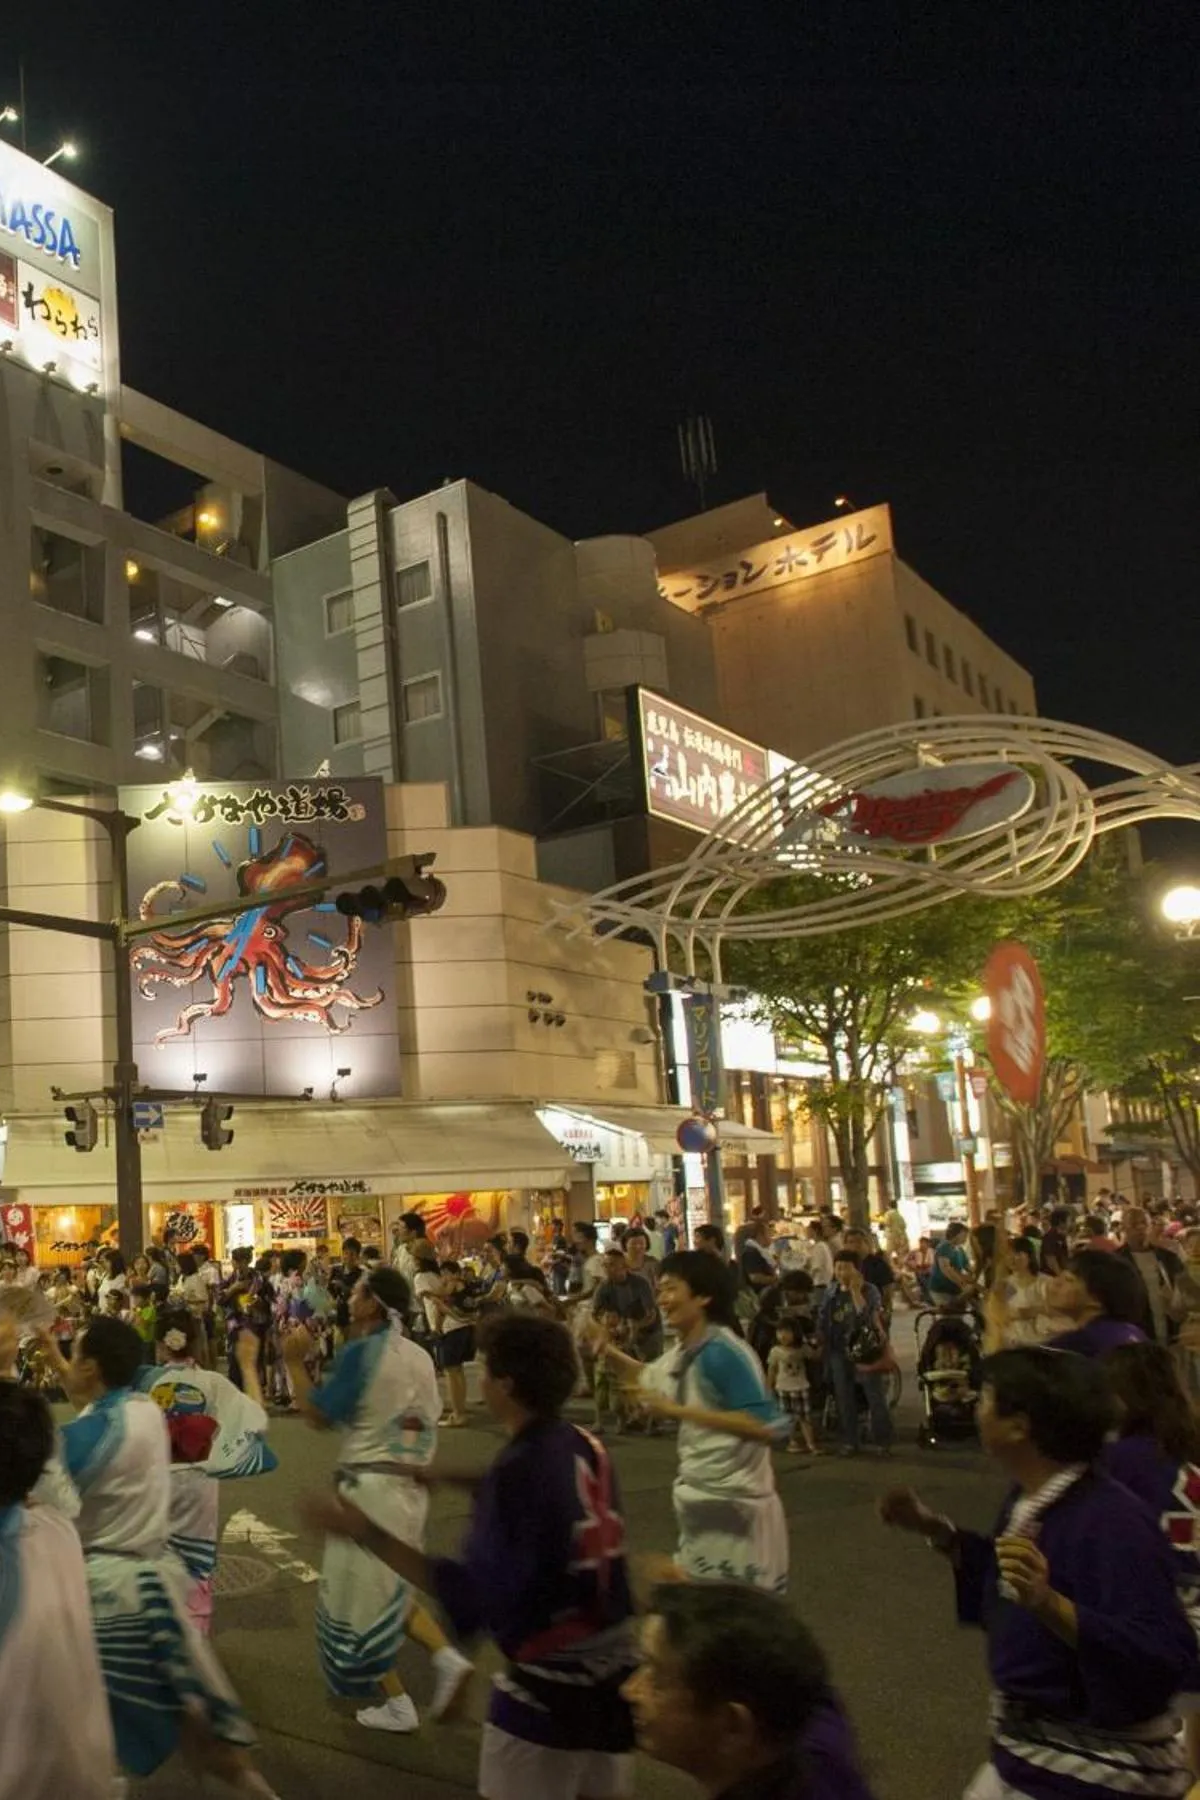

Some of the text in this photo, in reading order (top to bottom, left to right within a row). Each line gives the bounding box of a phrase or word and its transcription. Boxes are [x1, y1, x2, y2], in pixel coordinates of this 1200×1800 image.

[22, 281, 99, 340] わらわら
[658, 523, 877, 599] ーションホテル
